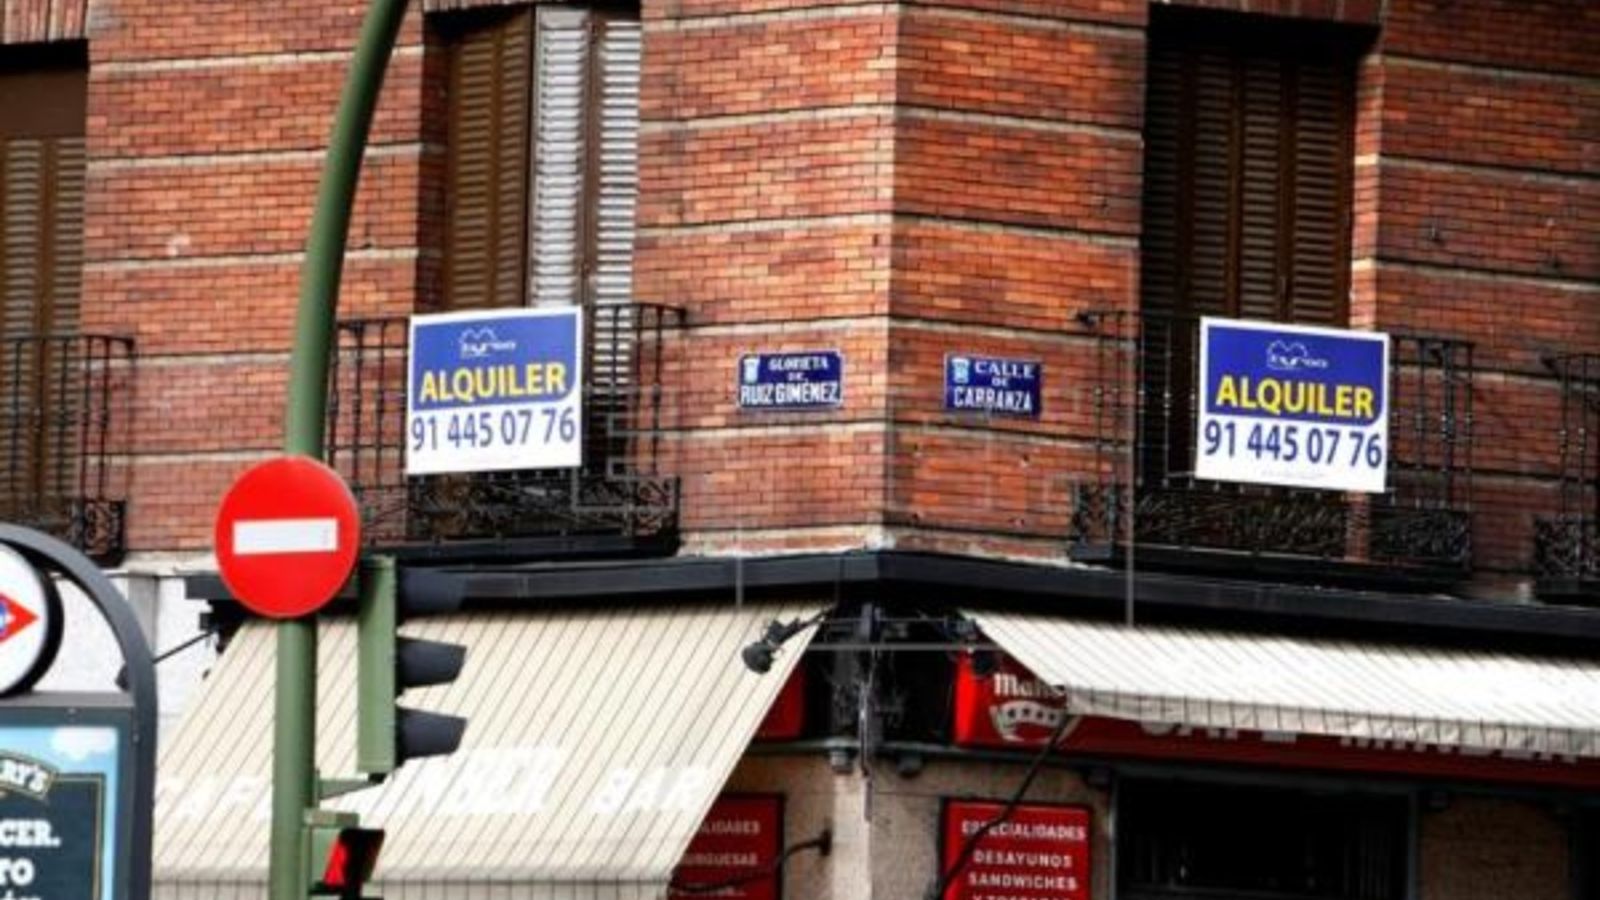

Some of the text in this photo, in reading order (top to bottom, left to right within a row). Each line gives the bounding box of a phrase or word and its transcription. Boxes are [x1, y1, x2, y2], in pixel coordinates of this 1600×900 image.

[768, 356, 829, 371] GLORIETA
[975, 360, 1034, 379] CALLE
[420, 361, 567, 403] ALQUILER
[741, 382, 773, 405] RUIZ
[992, 377, 1008, 387] DE
[954, 386, 1032, 412] CARRANZA
[1215, 374, 1375, 424] ALQUILER
[411, 406, 577, 452] 91 445 07 76
[1204, 419, 1383, 469] 91 445 07 76
[973, 848, 1073, 868] DESAYUNOS
[969, 872, 1077, 891] SANDWICHES
